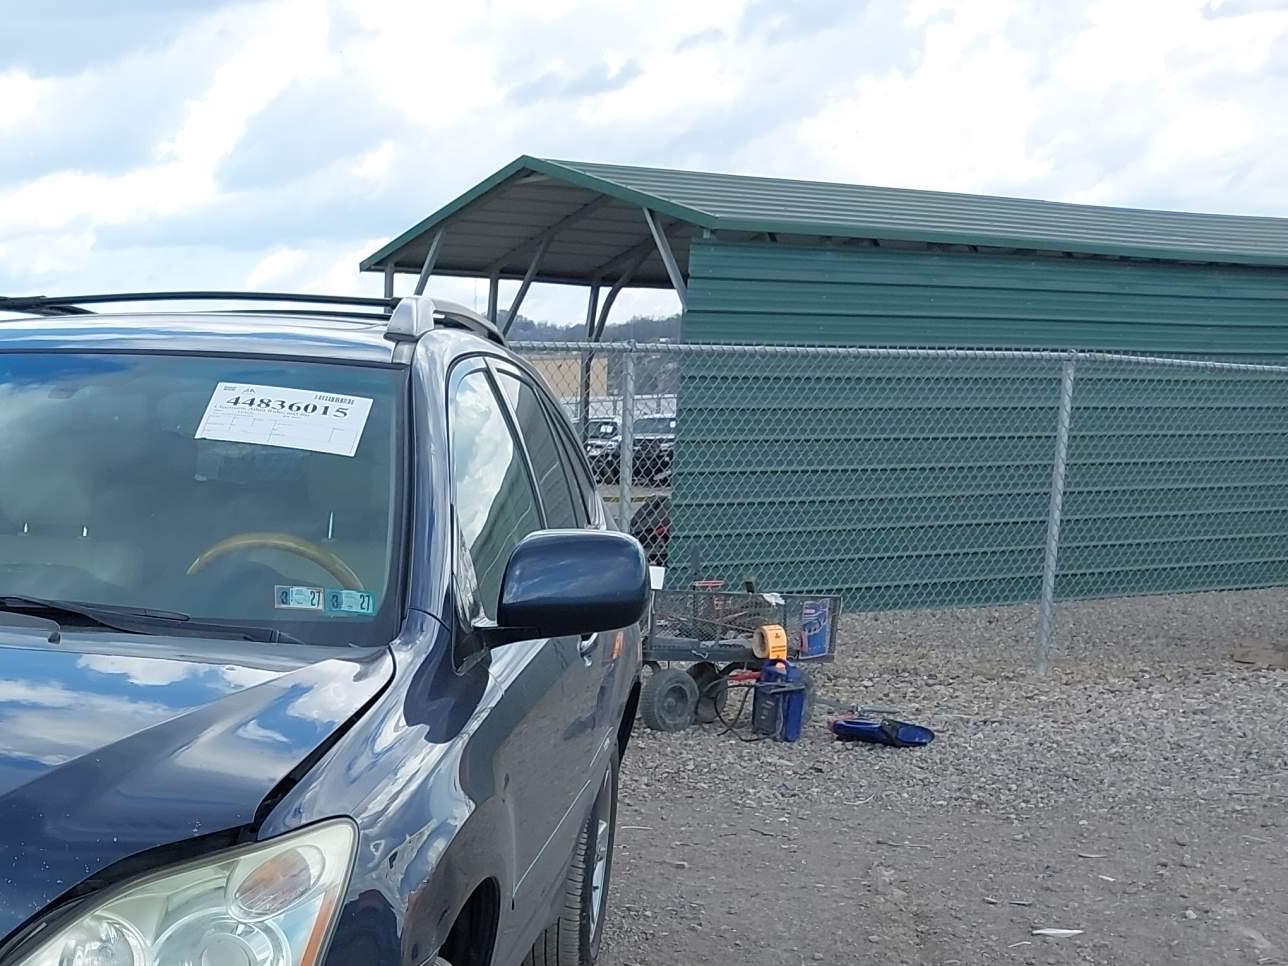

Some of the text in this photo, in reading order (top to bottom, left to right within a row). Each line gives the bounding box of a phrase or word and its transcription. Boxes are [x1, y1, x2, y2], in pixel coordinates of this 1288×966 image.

[226, 396, 350, 418] 44836015
[309, 591, 321, 608] 27
[359, 594, 370, 612] 27
